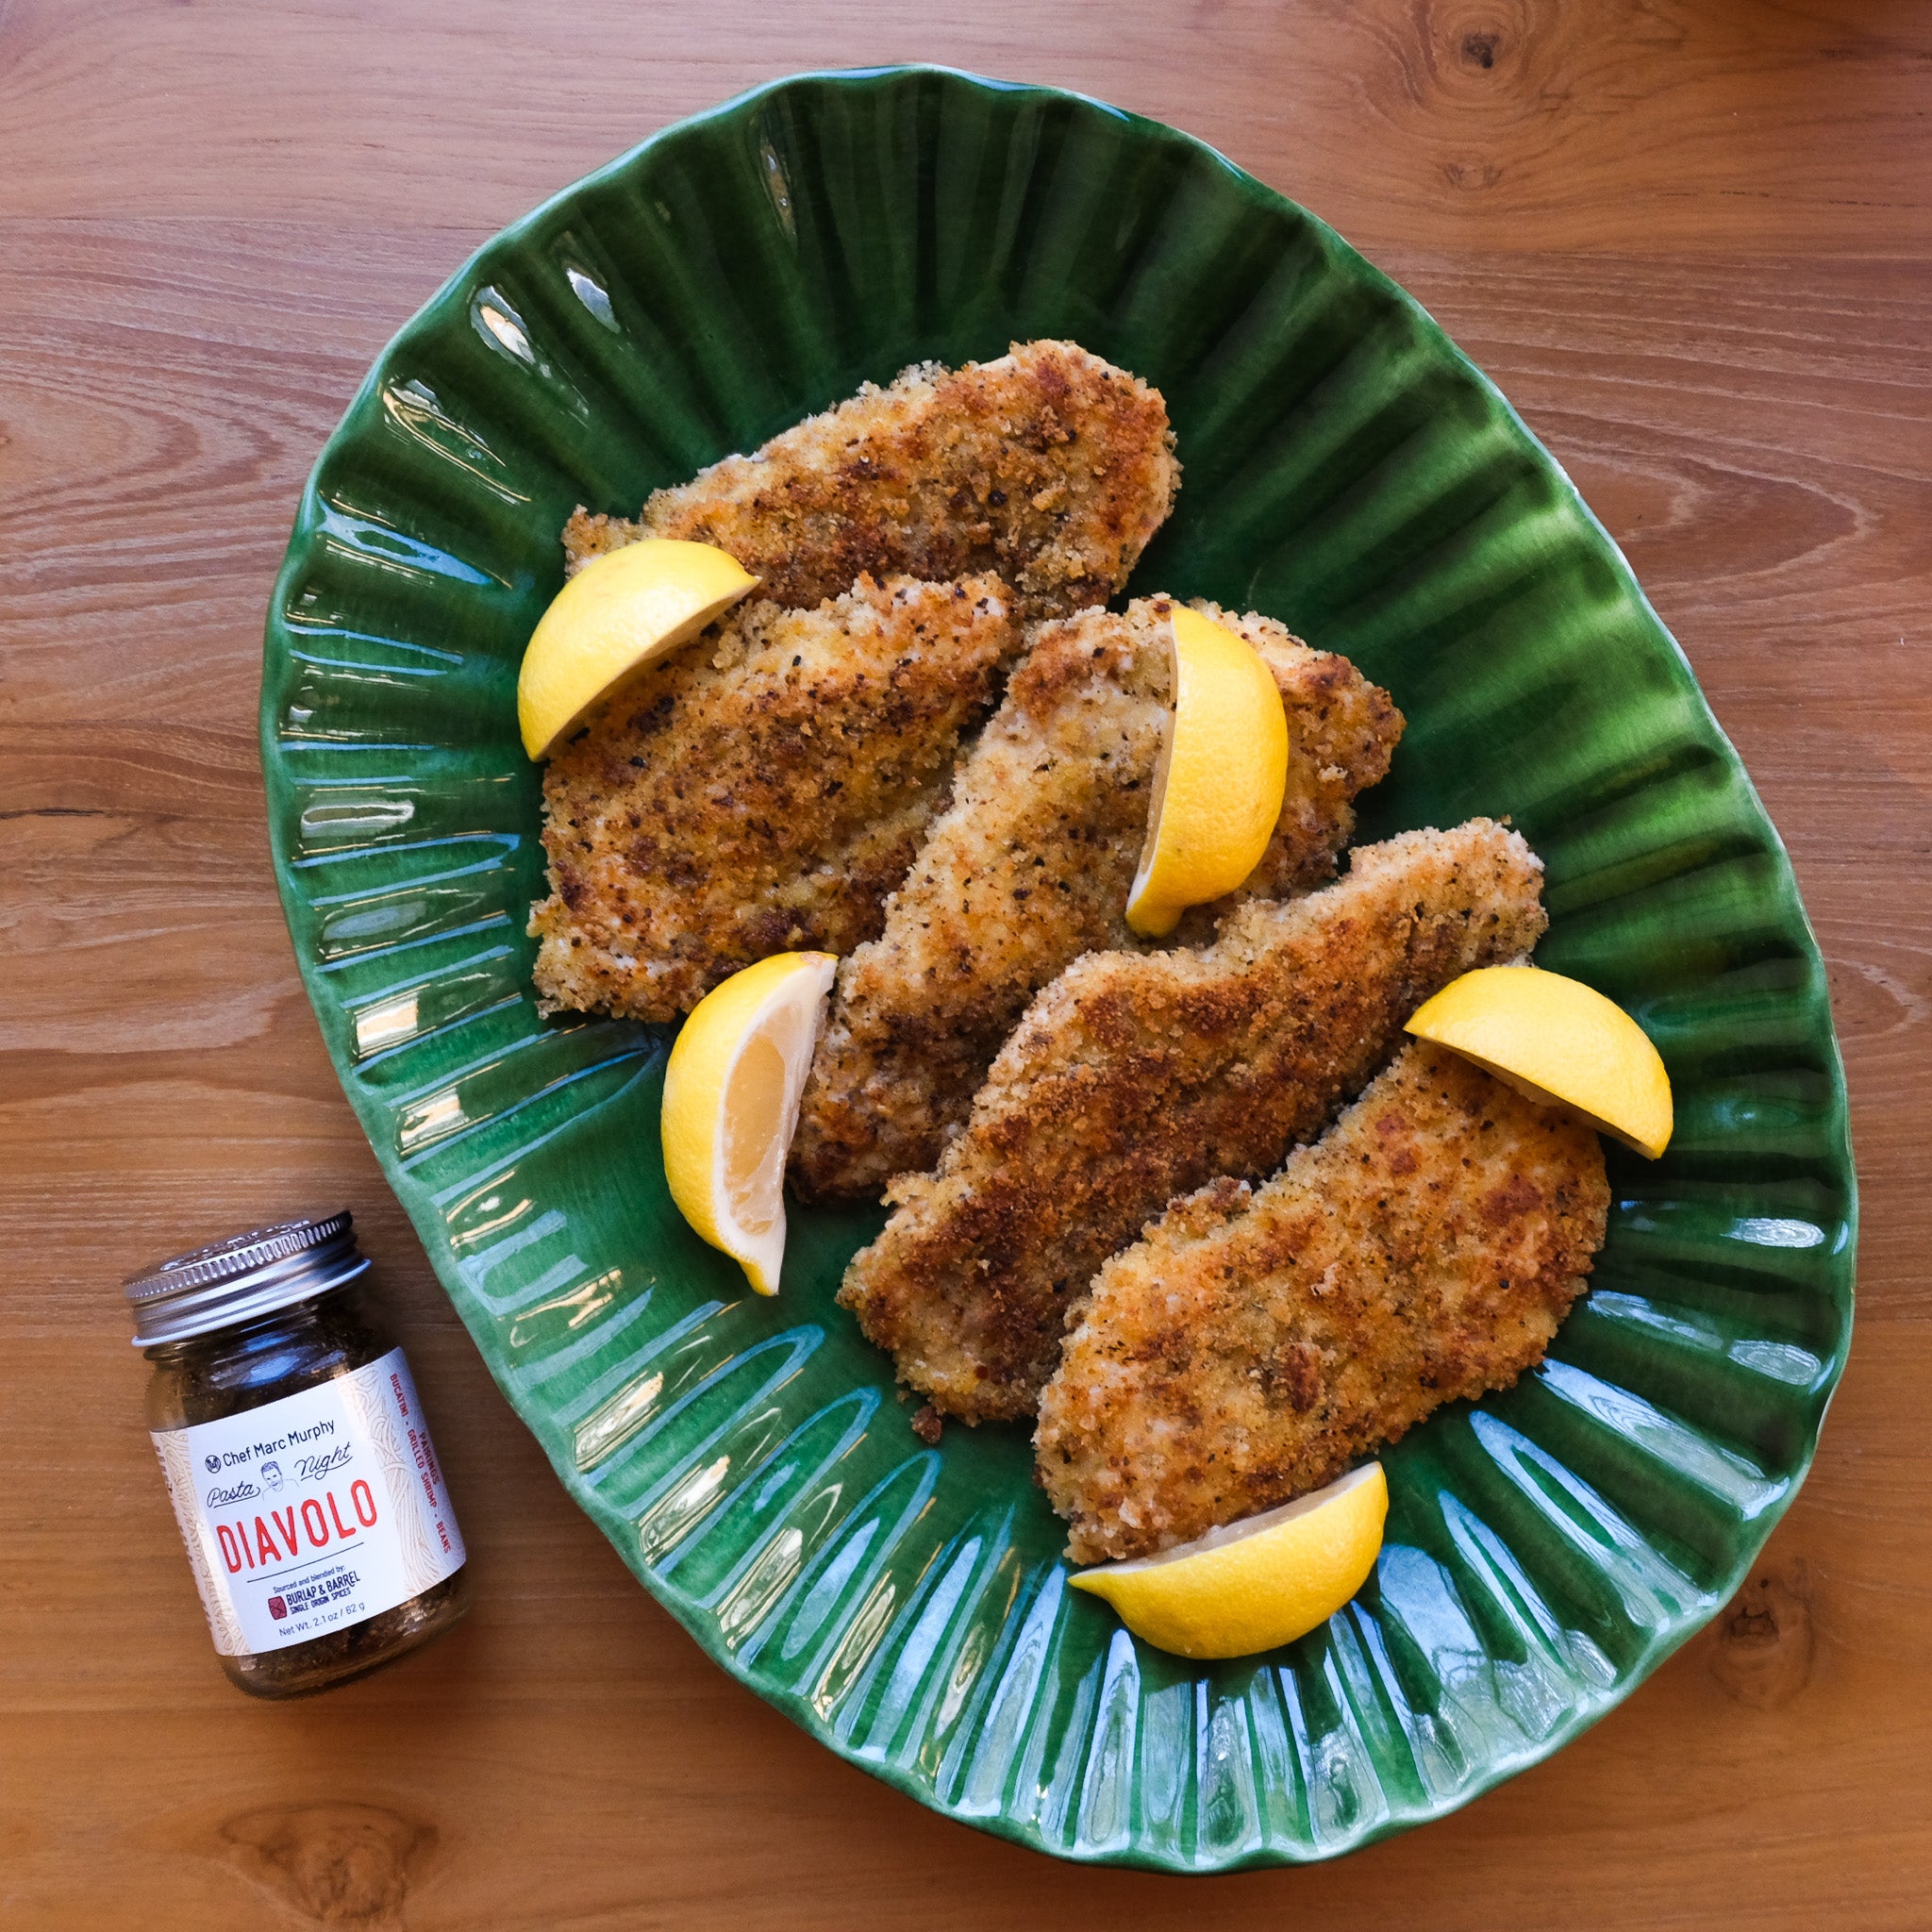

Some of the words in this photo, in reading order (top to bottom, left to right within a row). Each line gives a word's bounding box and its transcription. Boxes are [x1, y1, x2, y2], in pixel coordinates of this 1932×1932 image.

[223, 1447, 251, 1467] Chef
[254, 1439, 287, 1457] Marc
[288, 1420, 335, 1447] Murphy
[207, 1481, 262, 1508] Pasta
[294, 1442, 354, 1481] Night
[216, 1479, 377, 1574] DIAVOLO
[421, 1474, 437, 1507] SHRIMP
[437, 1522, 451, 1555] BEANS
[273, 1582, 297, 1593] Sourced
[299, 1576, 309, 1586] and
[310, 1569, 335, 1581] blended
[286, 1587, 316, 1605] BURLAP
[319, 1584, 325, 1594] &
[326, 1571, 360, 1592] BARREL
[279, 1626, 295, 1637] Net
[296, 1622, 312, 1631] Wt.
[345, 1604, 357, 1614] 62
[358, 1603, 365, 1611] g
[290, 1603, 309, 1615] SINGLE
[310, 1596, 329, 1607] ORIGIN
[331, 1588, 351, 1601] SPICES
